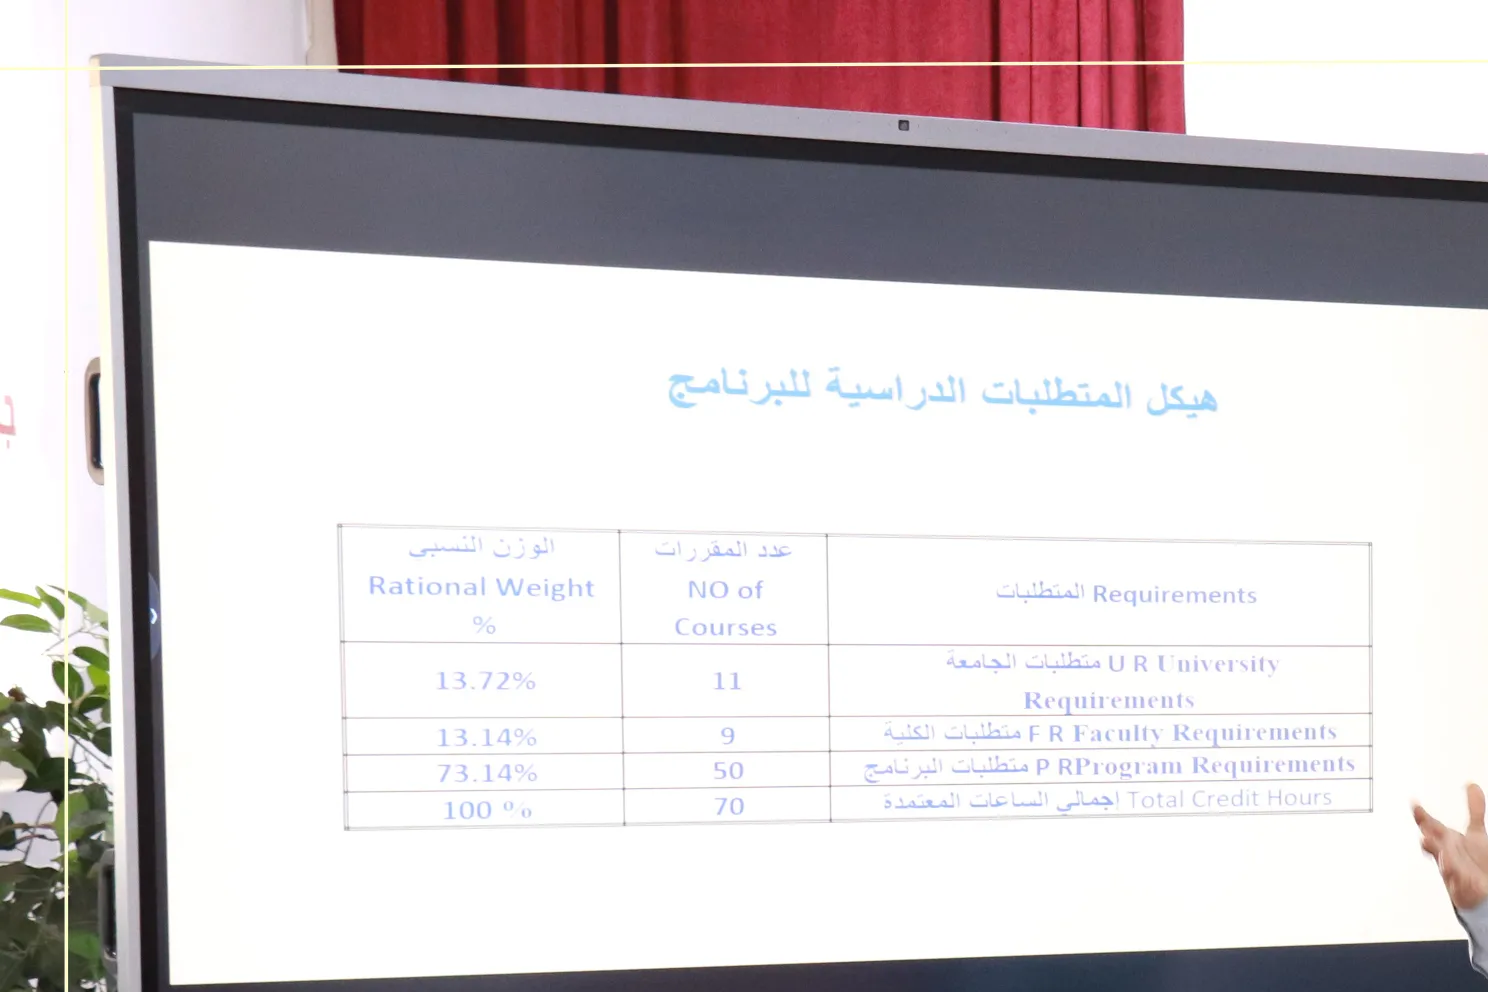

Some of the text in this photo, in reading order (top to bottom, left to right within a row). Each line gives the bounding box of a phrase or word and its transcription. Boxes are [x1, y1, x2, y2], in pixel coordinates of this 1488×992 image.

[668, 366, 1220, 421] هيكل المتطلبات الدراسية للبرنامج
[493, 537, 556, 561] الوزن
[655, 541, 793, 564] عدد المقررات
[370, 576, 596, 603] Rational Weight
[689, 580, 765, 601] NO of
[997, 581, 1259, 609] المتطلبات Requirements
[473, 616, 498, 636] %
[675, 618, 779, 638] Courses
[947, 652, 1278, 679] متطلبات الجامعة U R University
[439, 671, 538, 692] 13.72%
[715, 672, 742, 692] 11
[1020, 692, 1196, 718] Requirements
[440, 728, 538, 749] 13.14%
[721, 727, 737, 747] 9
[884, 721, 1338, 749] متطلبات الكلية F R Faculty Requirements
[440, 764, 539, 784] 73.14%
[714, 762, 746, 781] 50
[864, 758, 944, 784] البرنامج
[952, 755, 1030, 780] متطلبات
[1037, 759, 1052, 778] P
[1193, 756, 1357, 779] Requirements
[715, 798, 746, 817] 70
[885, 792, 962, 811] المعتمدة
[970, 791, 1050, 810] الساعات
[1131, 791, 1185, 810] Total
[1193, 790, 1260, 809] Credit
[1269, 790, 1333, 807] Hours
[447, 801, 534, 821] 100 %
